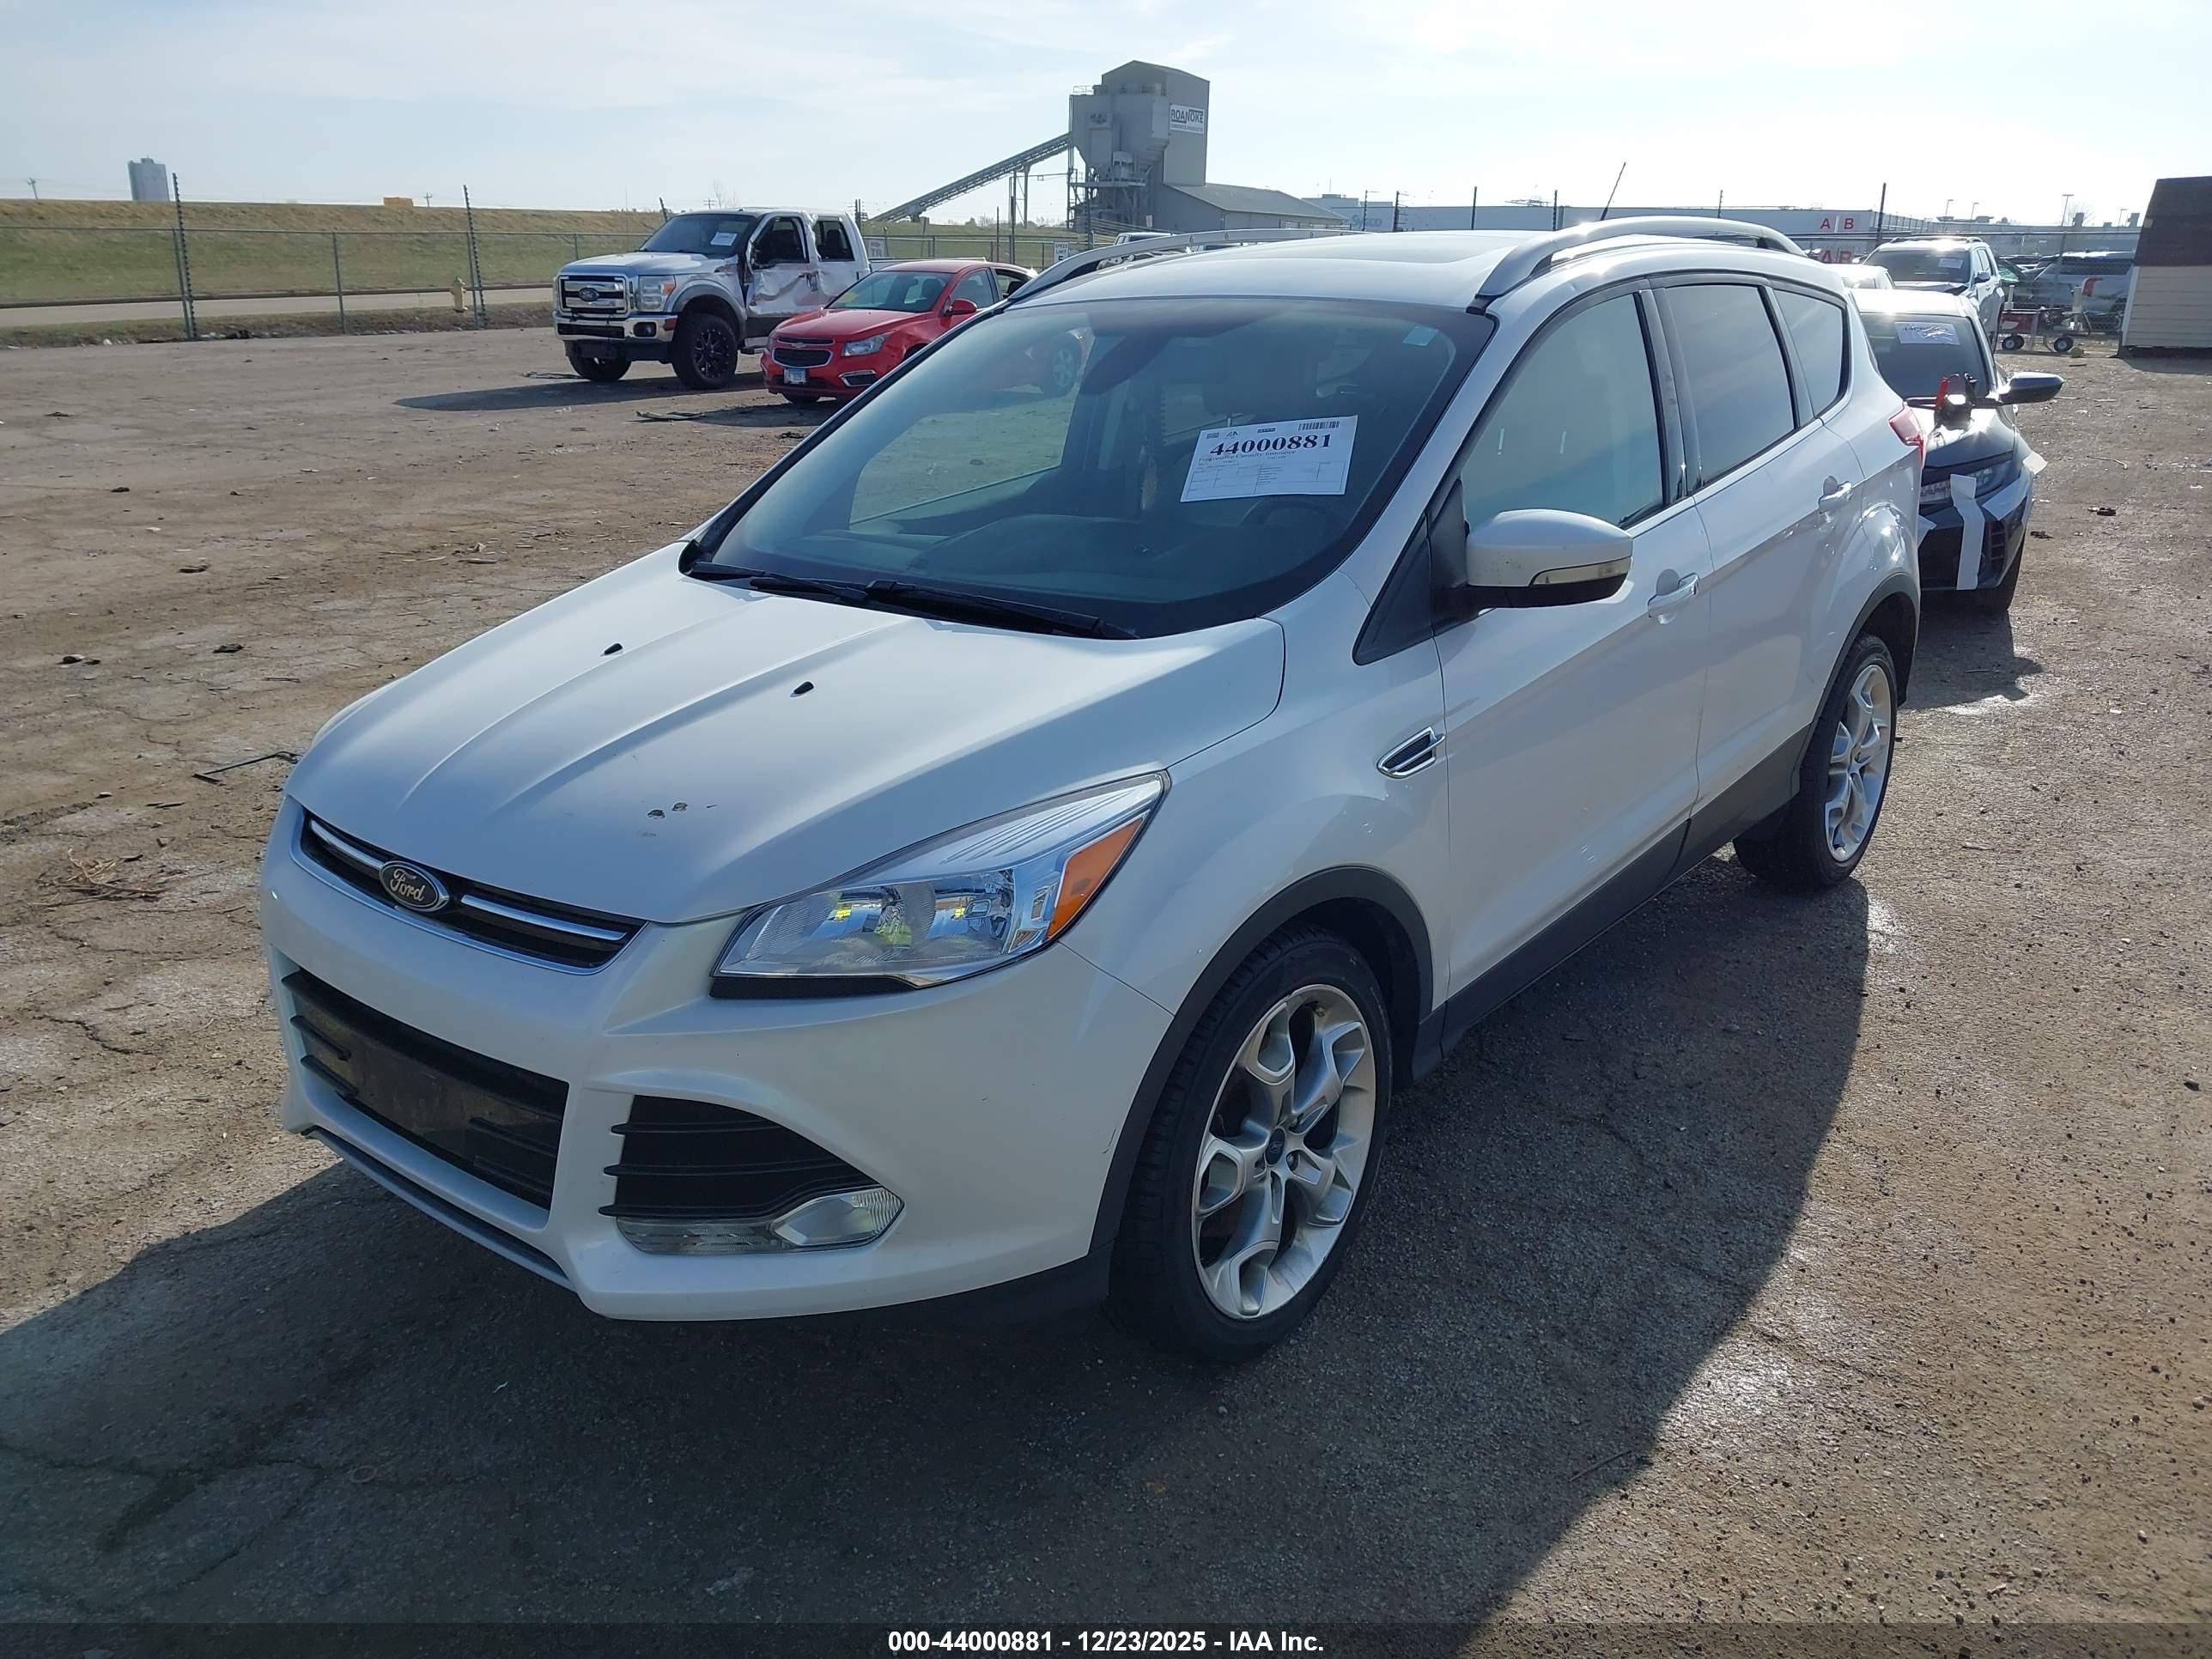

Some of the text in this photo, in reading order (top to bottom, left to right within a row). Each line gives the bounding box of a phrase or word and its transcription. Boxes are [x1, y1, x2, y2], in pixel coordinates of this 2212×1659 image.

[1171, 109, 1203, 124] ROANOKE
[1820, 218, 1854, 229] A B
[1209, 434, 1332, 456] 44000881
[390, 868, 426, 902] Ford
